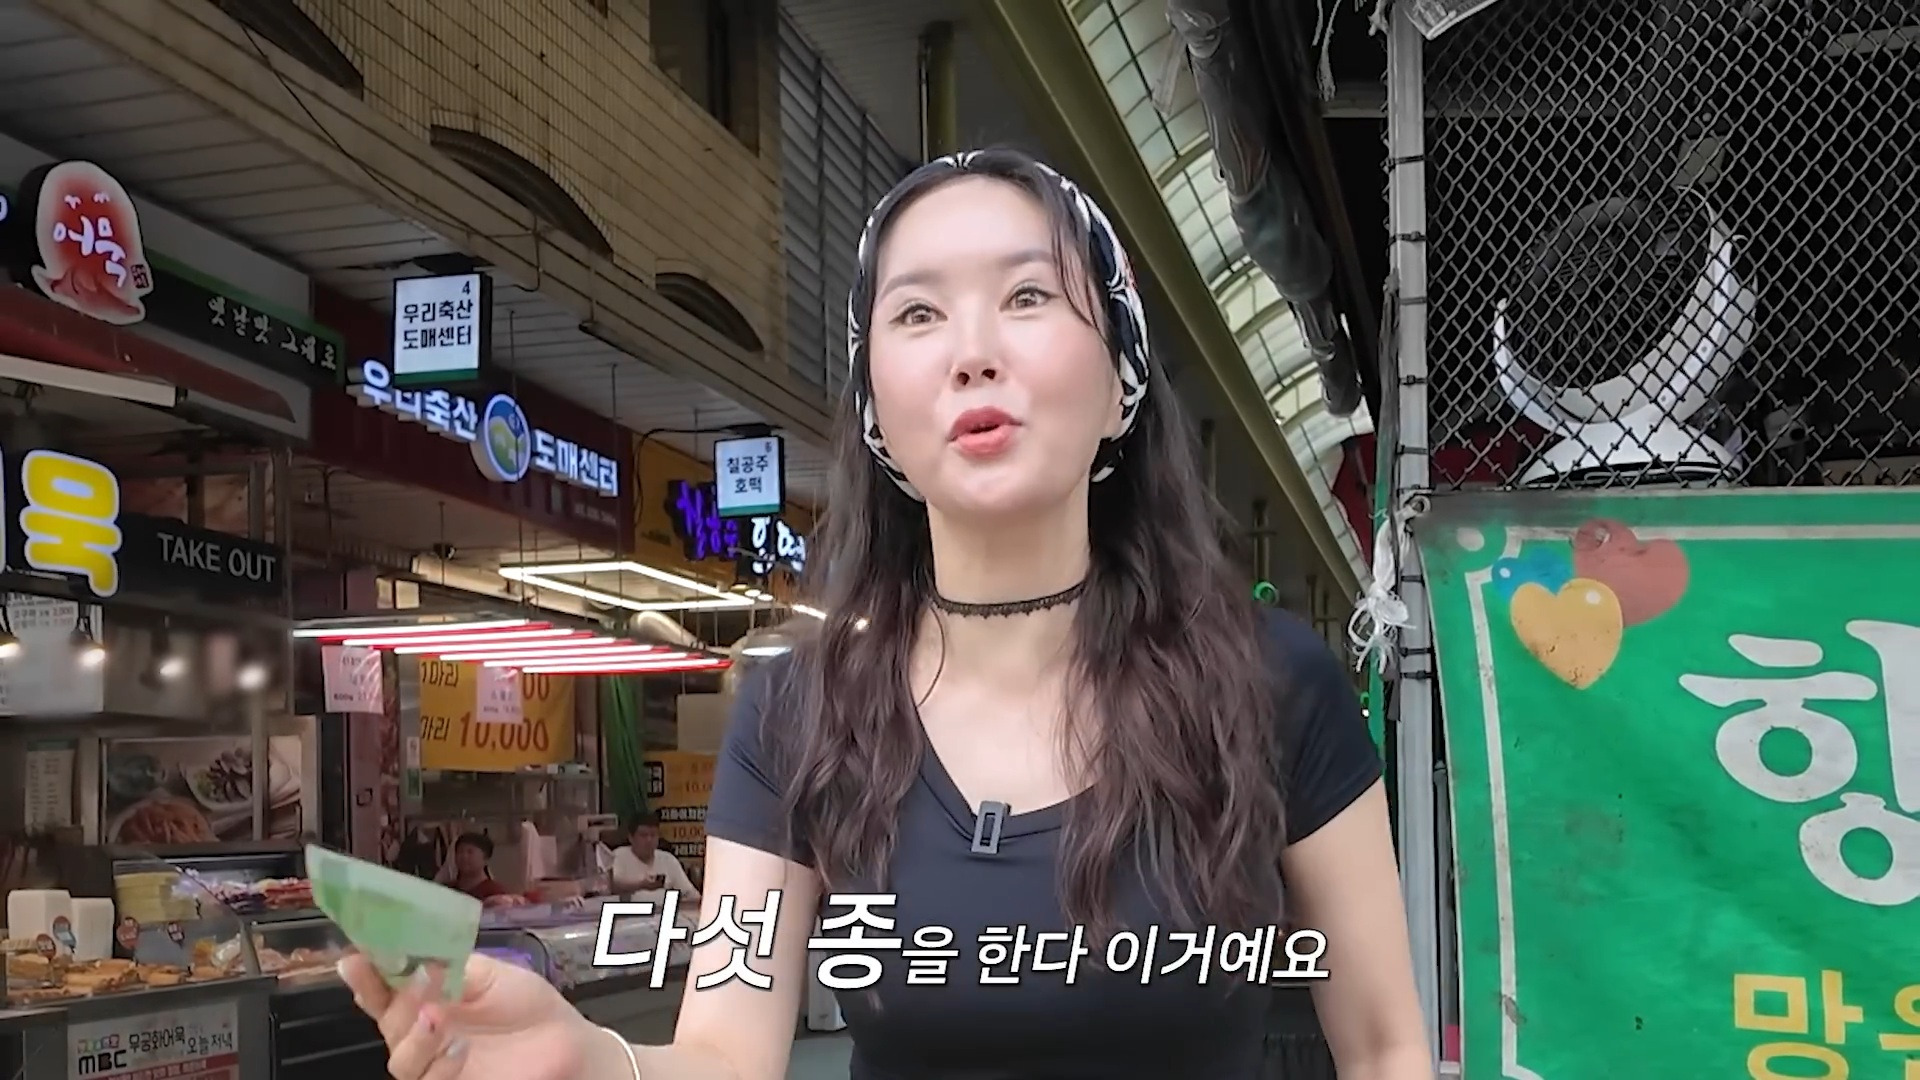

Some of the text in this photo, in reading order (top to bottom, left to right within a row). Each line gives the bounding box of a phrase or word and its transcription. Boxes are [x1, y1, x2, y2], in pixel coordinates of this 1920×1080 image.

[53, 215, 127, 288] 어묵
[462, 280, 471, 295] 4
[403, 299, 474, 324] 우리축산
[403, 325, 472, 350] 도매센터
[363, 360, 619, 497] 우리축산 도매센터
[727, 455, 768, 474] 칠공주
[734, 476, 763, 494] 호떡
[157, 532, 276, 583] TAKE OUT
[460, 710, 549, 752] 10,000
[78, 1049, 127, 1075] MBC
